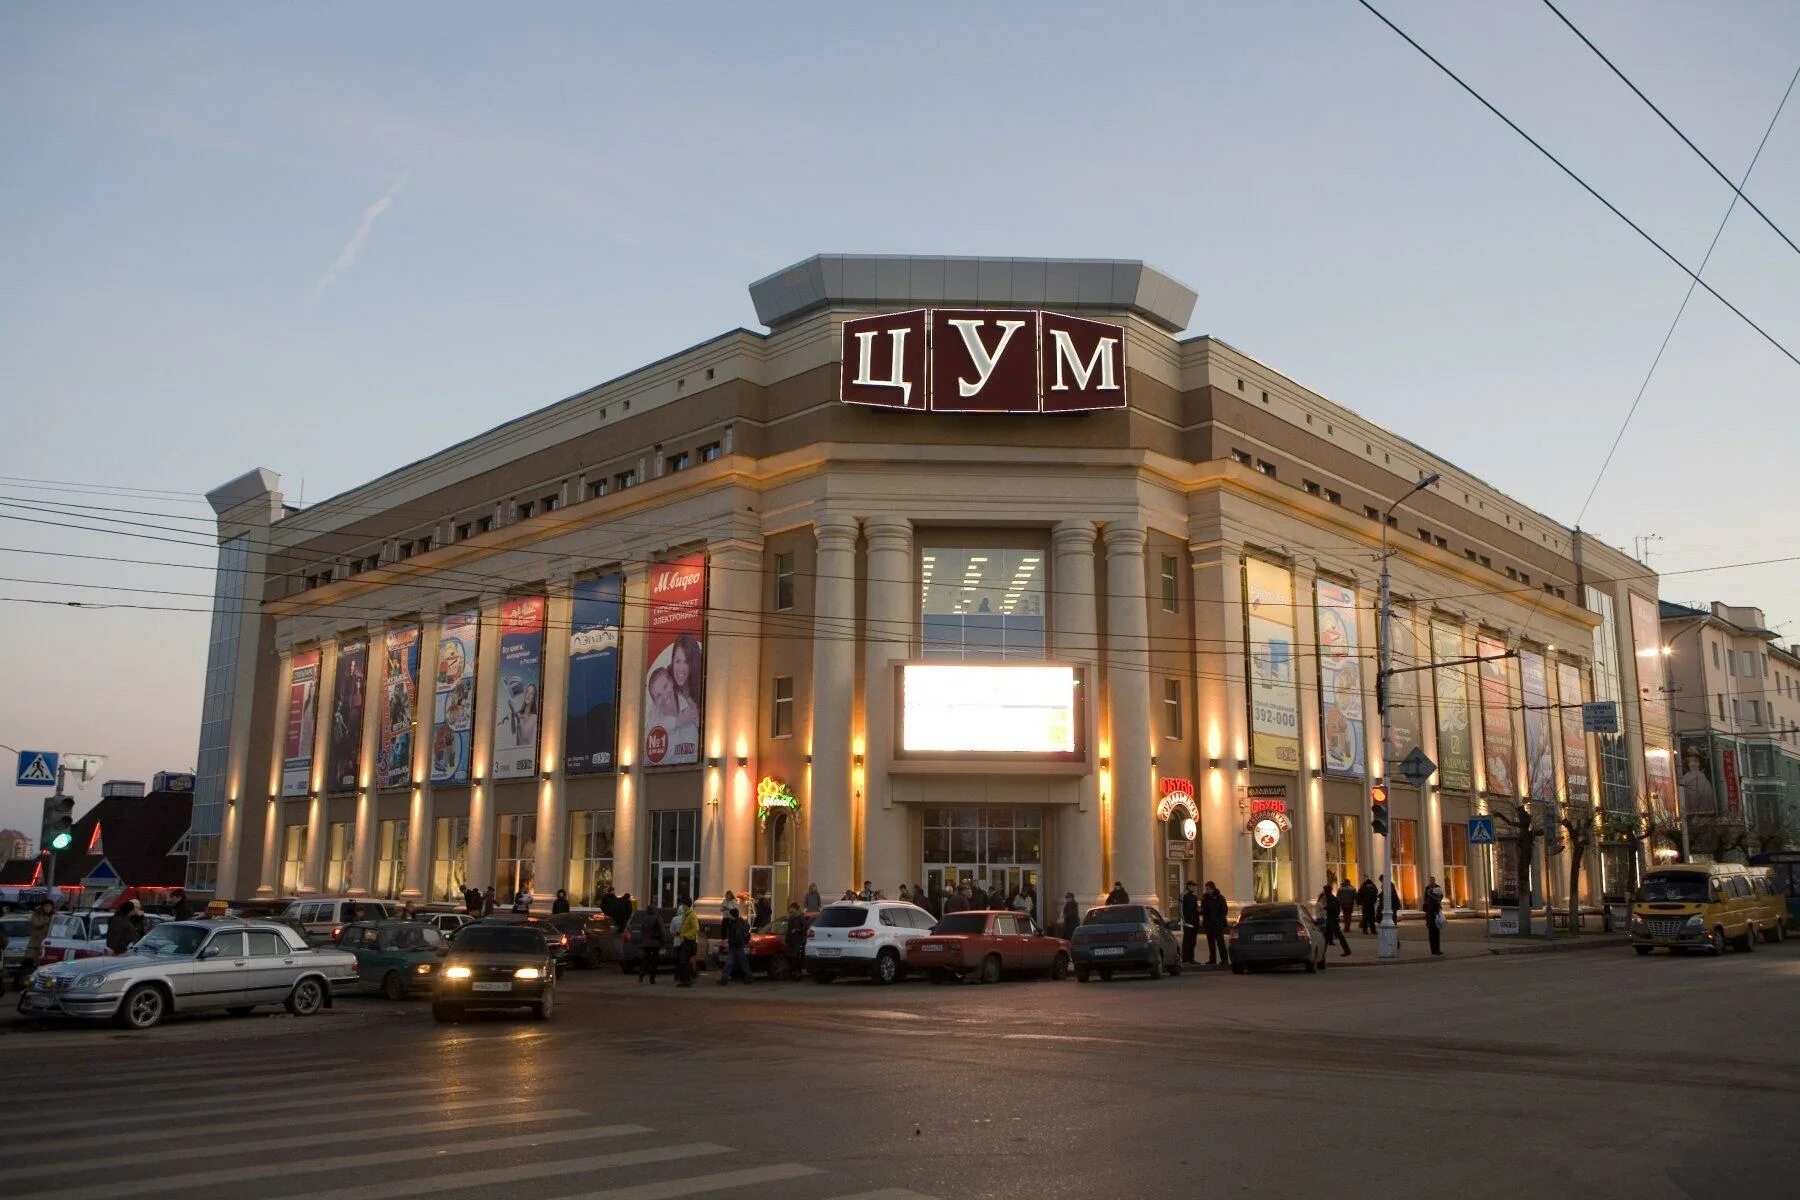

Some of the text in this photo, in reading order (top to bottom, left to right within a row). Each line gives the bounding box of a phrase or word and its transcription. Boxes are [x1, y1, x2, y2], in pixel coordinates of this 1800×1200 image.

[852, 318, 1120, 405] ЦУМ
[1254, 707, 1295, 727] 392-000
[1252, 799, 1286, 813] ОБУВЬ
